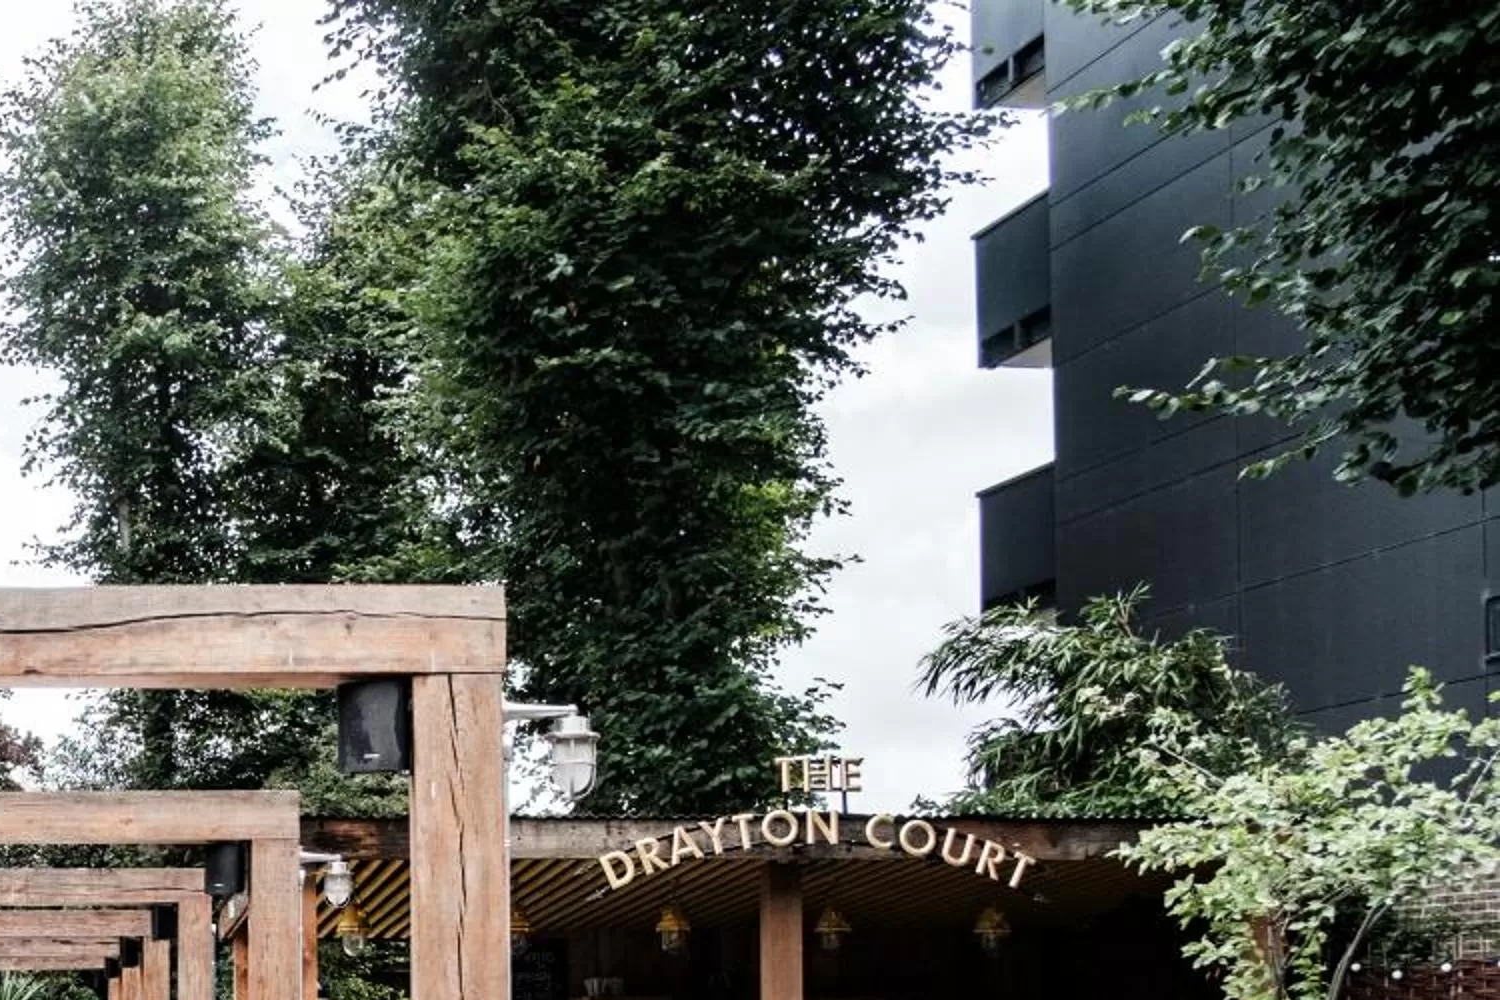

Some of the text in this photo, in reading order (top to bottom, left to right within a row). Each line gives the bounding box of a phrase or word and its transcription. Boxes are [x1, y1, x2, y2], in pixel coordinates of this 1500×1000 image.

[774, 756, 864, 793] THE
[599, 810, 1035, 890] DRAYTON COURT
